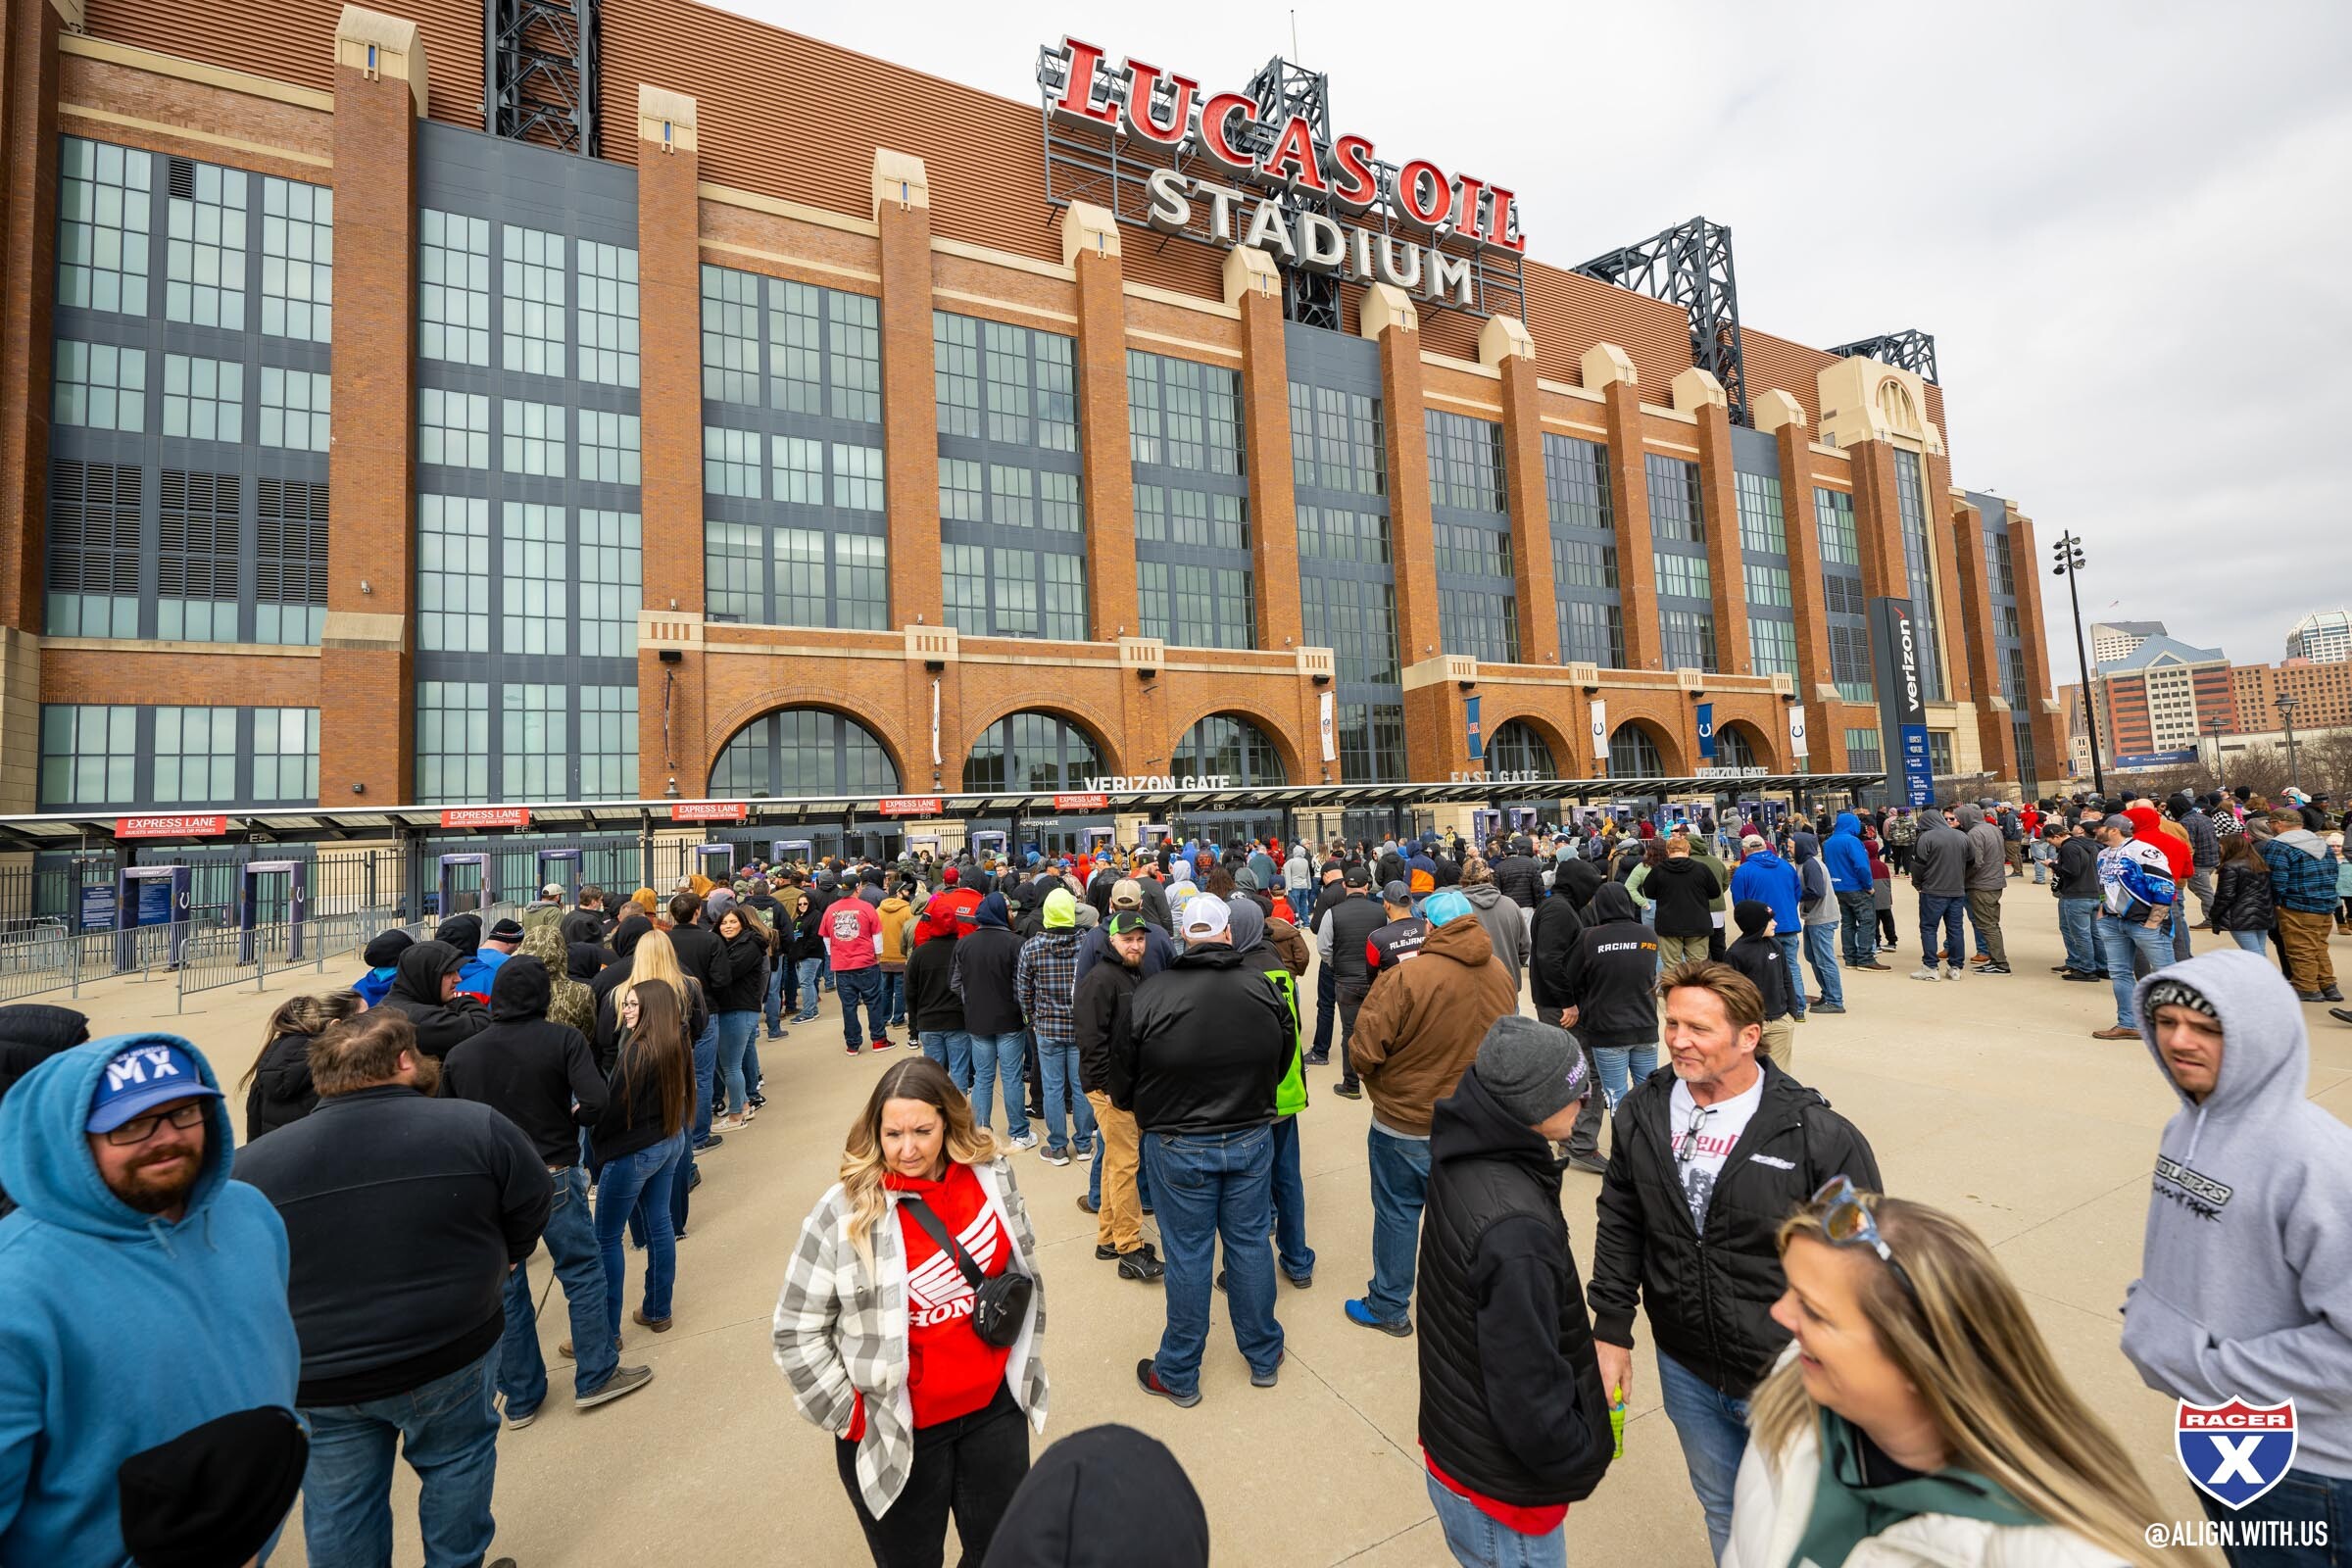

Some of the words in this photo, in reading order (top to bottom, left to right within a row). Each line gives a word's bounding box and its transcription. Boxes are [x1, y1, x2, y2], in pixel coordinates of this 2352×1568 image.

[1051, 34, 1377, 217] LUCAS
[1390, 158, 1527, 262] OIL
[1146, 168, 1473, 311] STADIUM
[1900, 618, 1919, 712] verizon
[1450, 770, 1492, 782] EAST
[1499, 769, 1540, 782] GATE
[1694, 766, 1740, 777] VERIZON
[1742, 765, 1769, 776] GATE
[1084, 775, 1176, 792] VERIZON
[1182, 774, 1230, 790] GATE
[679, 805, 716, 813] EXPRESS
[717, 804, 739, 812] LANE
[885, 800, 917, 808] EXPRESS
[917, 799, 936, 808] LANE
[1213, 803, 1226, 811] E10
[450, 809, 494, 820] EXPRESS
[496, 808, 521, 818] LANE
[127, 817, 183, 829] EXPRESS
[185, 816, 217, 828] LANE
[514, 824, 528, 833] E6
[1597, 942, 1637, 955] RACING
[1641, 942, 1657, 952] PRO
[106, 1050, 180, 1092] MX
[909, 1294, 978, 1328] HON
